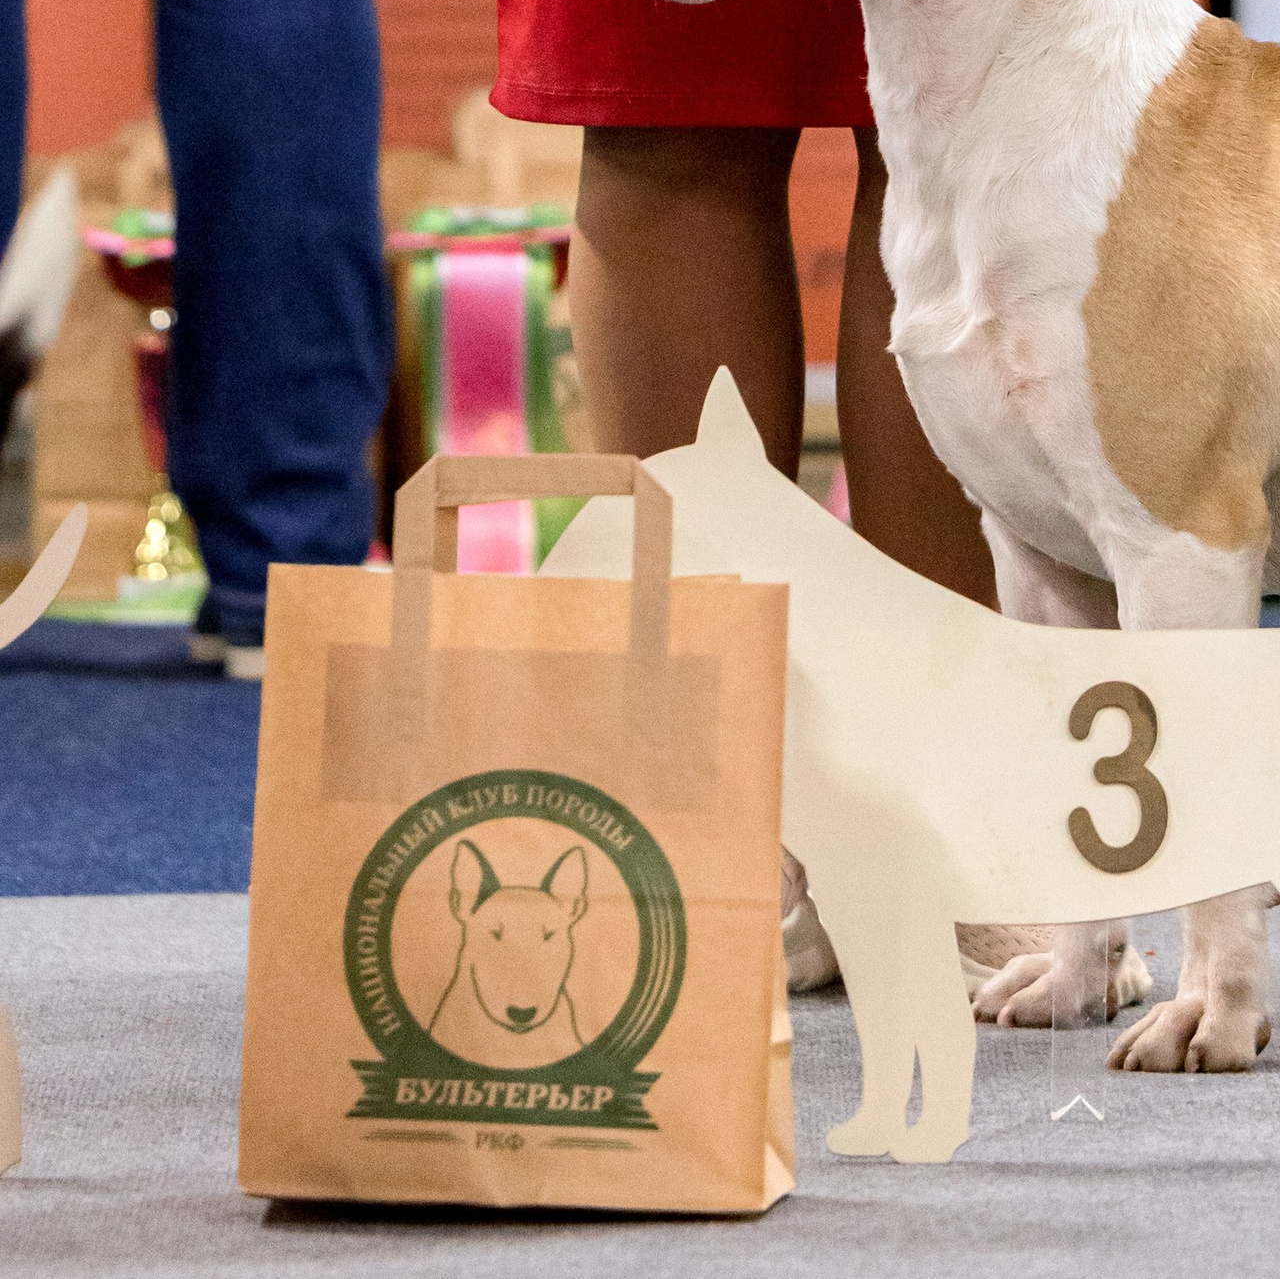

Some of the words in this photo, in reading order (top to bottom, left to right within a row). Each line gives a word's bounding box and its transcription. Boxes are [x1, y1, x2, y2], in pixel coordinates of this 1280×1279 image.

[1067, 680, 1169, 874] 3
[355, 808, 446, 1036] НАЦИОНАЛЬНЫЙ
[446, 783, 521, 822] КЛУБ
[526, 785, 634, 852] ПОРОДЫ
[395, 1076, 615, 1113] БУЛЬТЕРЬЕР
